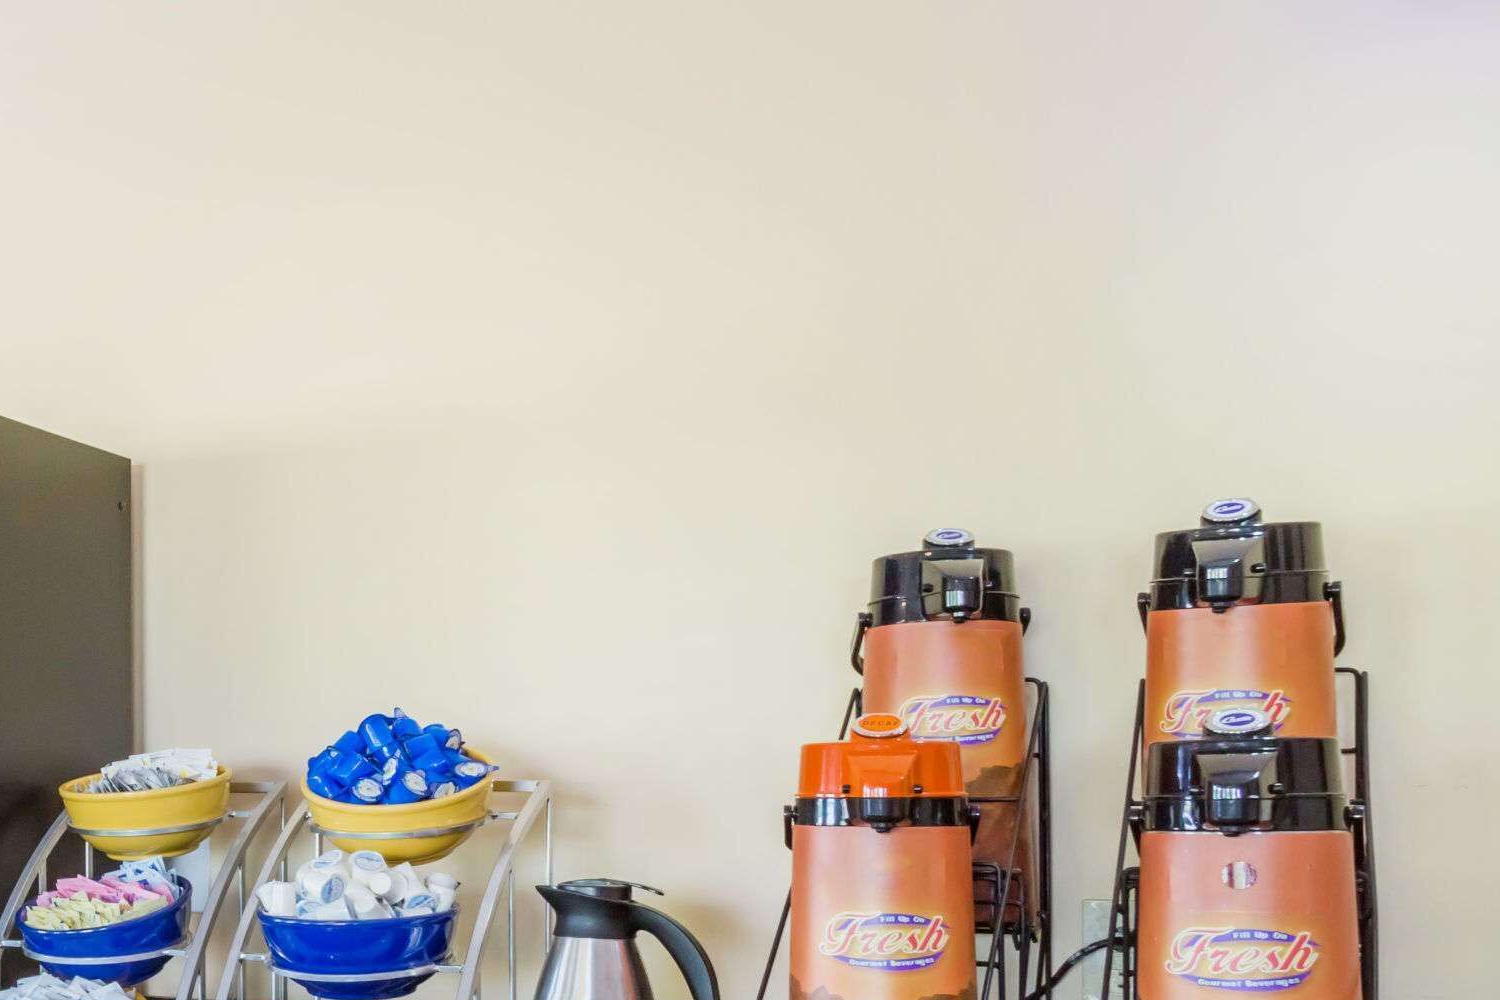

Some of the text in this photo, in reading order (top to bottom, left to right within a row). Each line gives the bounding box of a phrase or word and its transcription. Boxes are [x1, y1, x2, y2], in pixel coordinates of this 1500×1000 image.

[900, 696, 1006, 734] Fresh
[1160, 690, 1291, 733] Frh
[819, 912, 949, 955] Fresh
[1165, 927, 1319, 974] Fresh
[1233, 931, 1288, 940] Fill Up On
[1197, 977, 1301, 988] Gourmet Beverages
